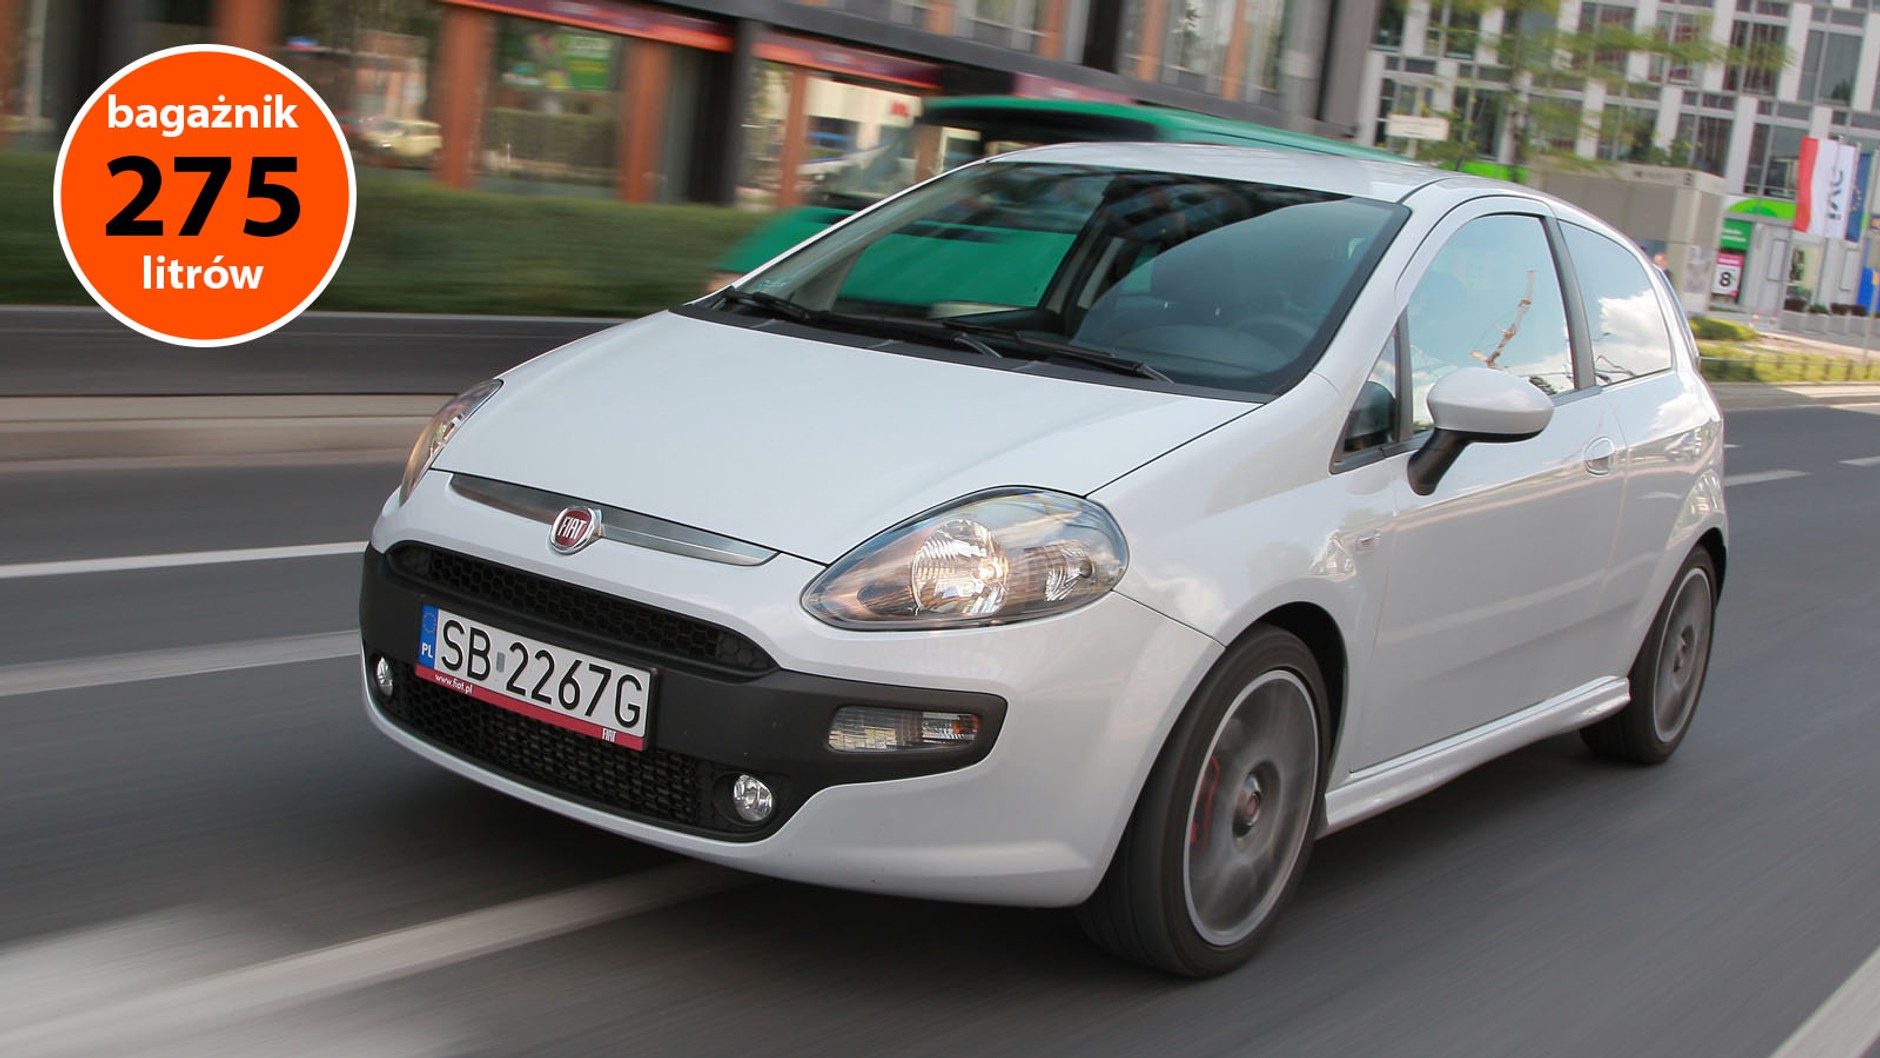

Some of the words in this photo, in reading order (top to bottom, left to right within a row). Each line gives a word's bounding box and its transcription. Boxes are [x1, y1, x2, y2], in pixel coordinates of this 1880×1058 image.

[1719, 271, 1731, 287] 8
[557, 516, 587, 539] FIAT
[421, 641, 433, 659] PL
[441, 619, 491, 681] SB
[506, 641, 642, 728] 2267G
[434, 673, 473, 694] www.fiat.pl
[601, 727, 617, 743] FIAT
